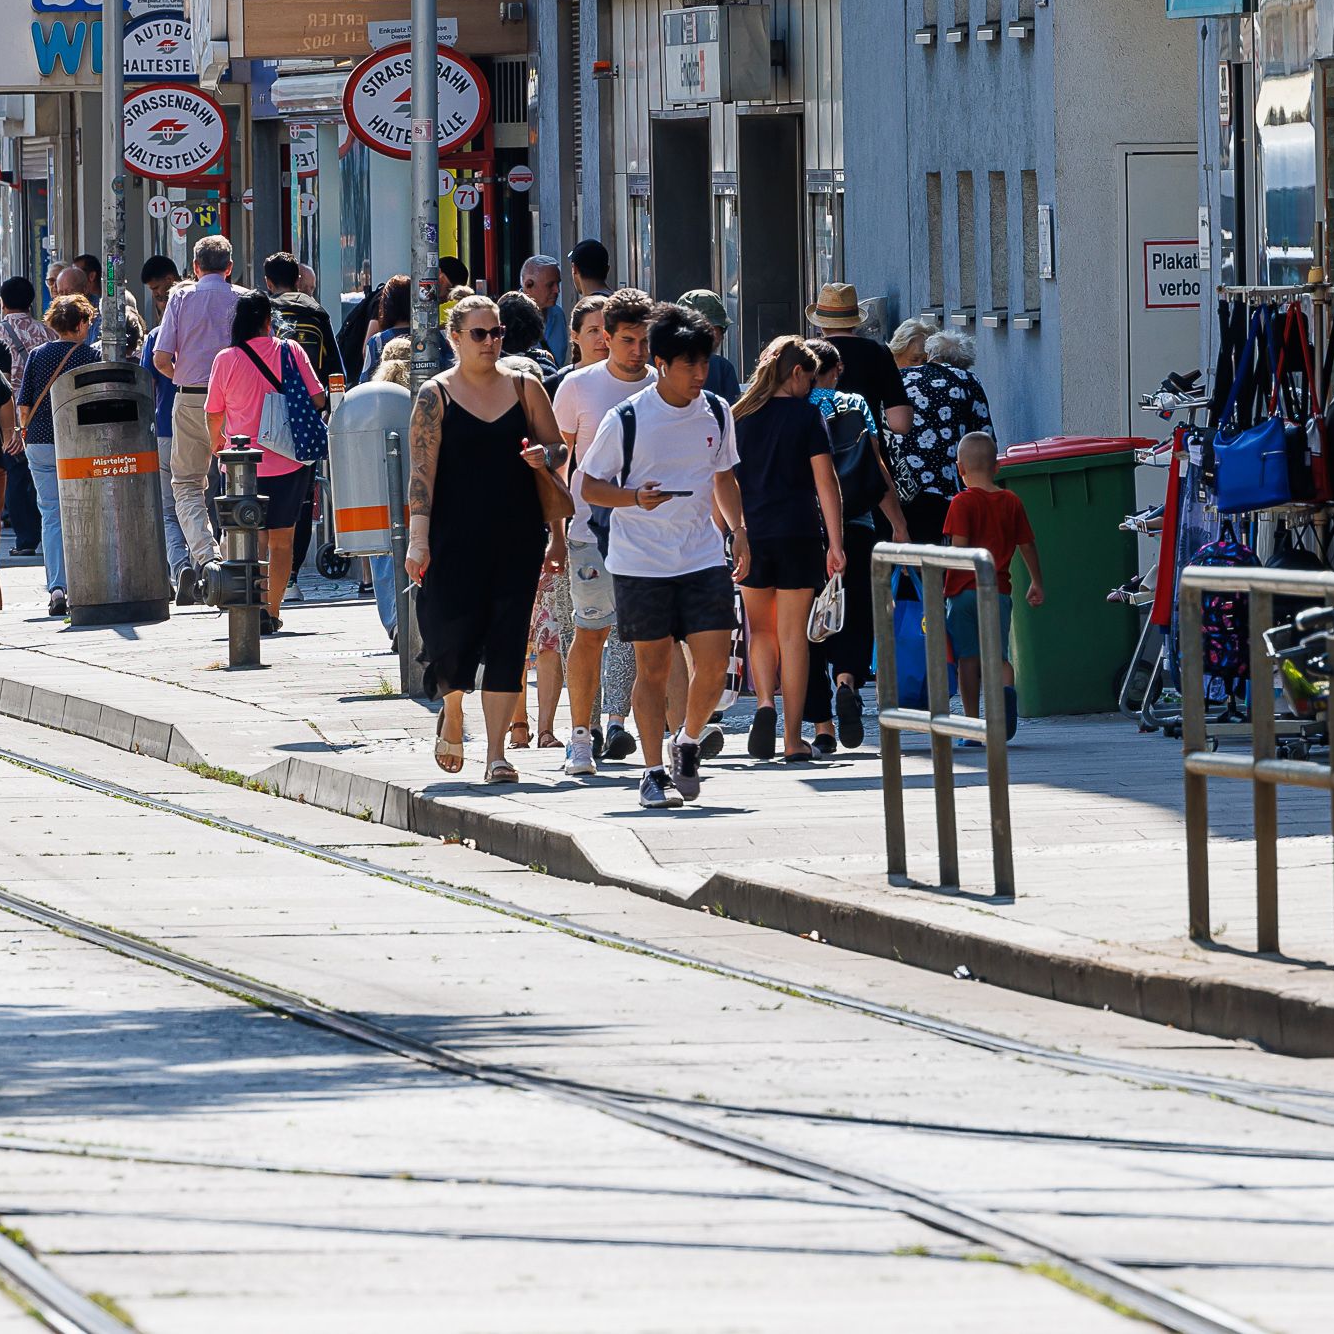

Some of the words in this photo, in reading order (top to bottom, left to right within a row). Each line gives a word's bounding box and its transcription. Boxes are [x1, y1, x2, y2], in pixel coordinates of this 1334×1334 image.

[134, 23, 192, 46] AUTOBU
[379, 26, 407, 34] Enkplatz
[361, 60, 471, 98] STRASSBAHN
[124, 94, 217, 127] STRASSENBAHN
[125, 141, 212, 169] HALTESTELLE
[458, 191, 475, 204] 71
[152, 202, 167, 213] 11
[174, 212, 192, 224] 71
[199, 213, 212, 226] N
[1159, 279, 1201, 296] verbo
